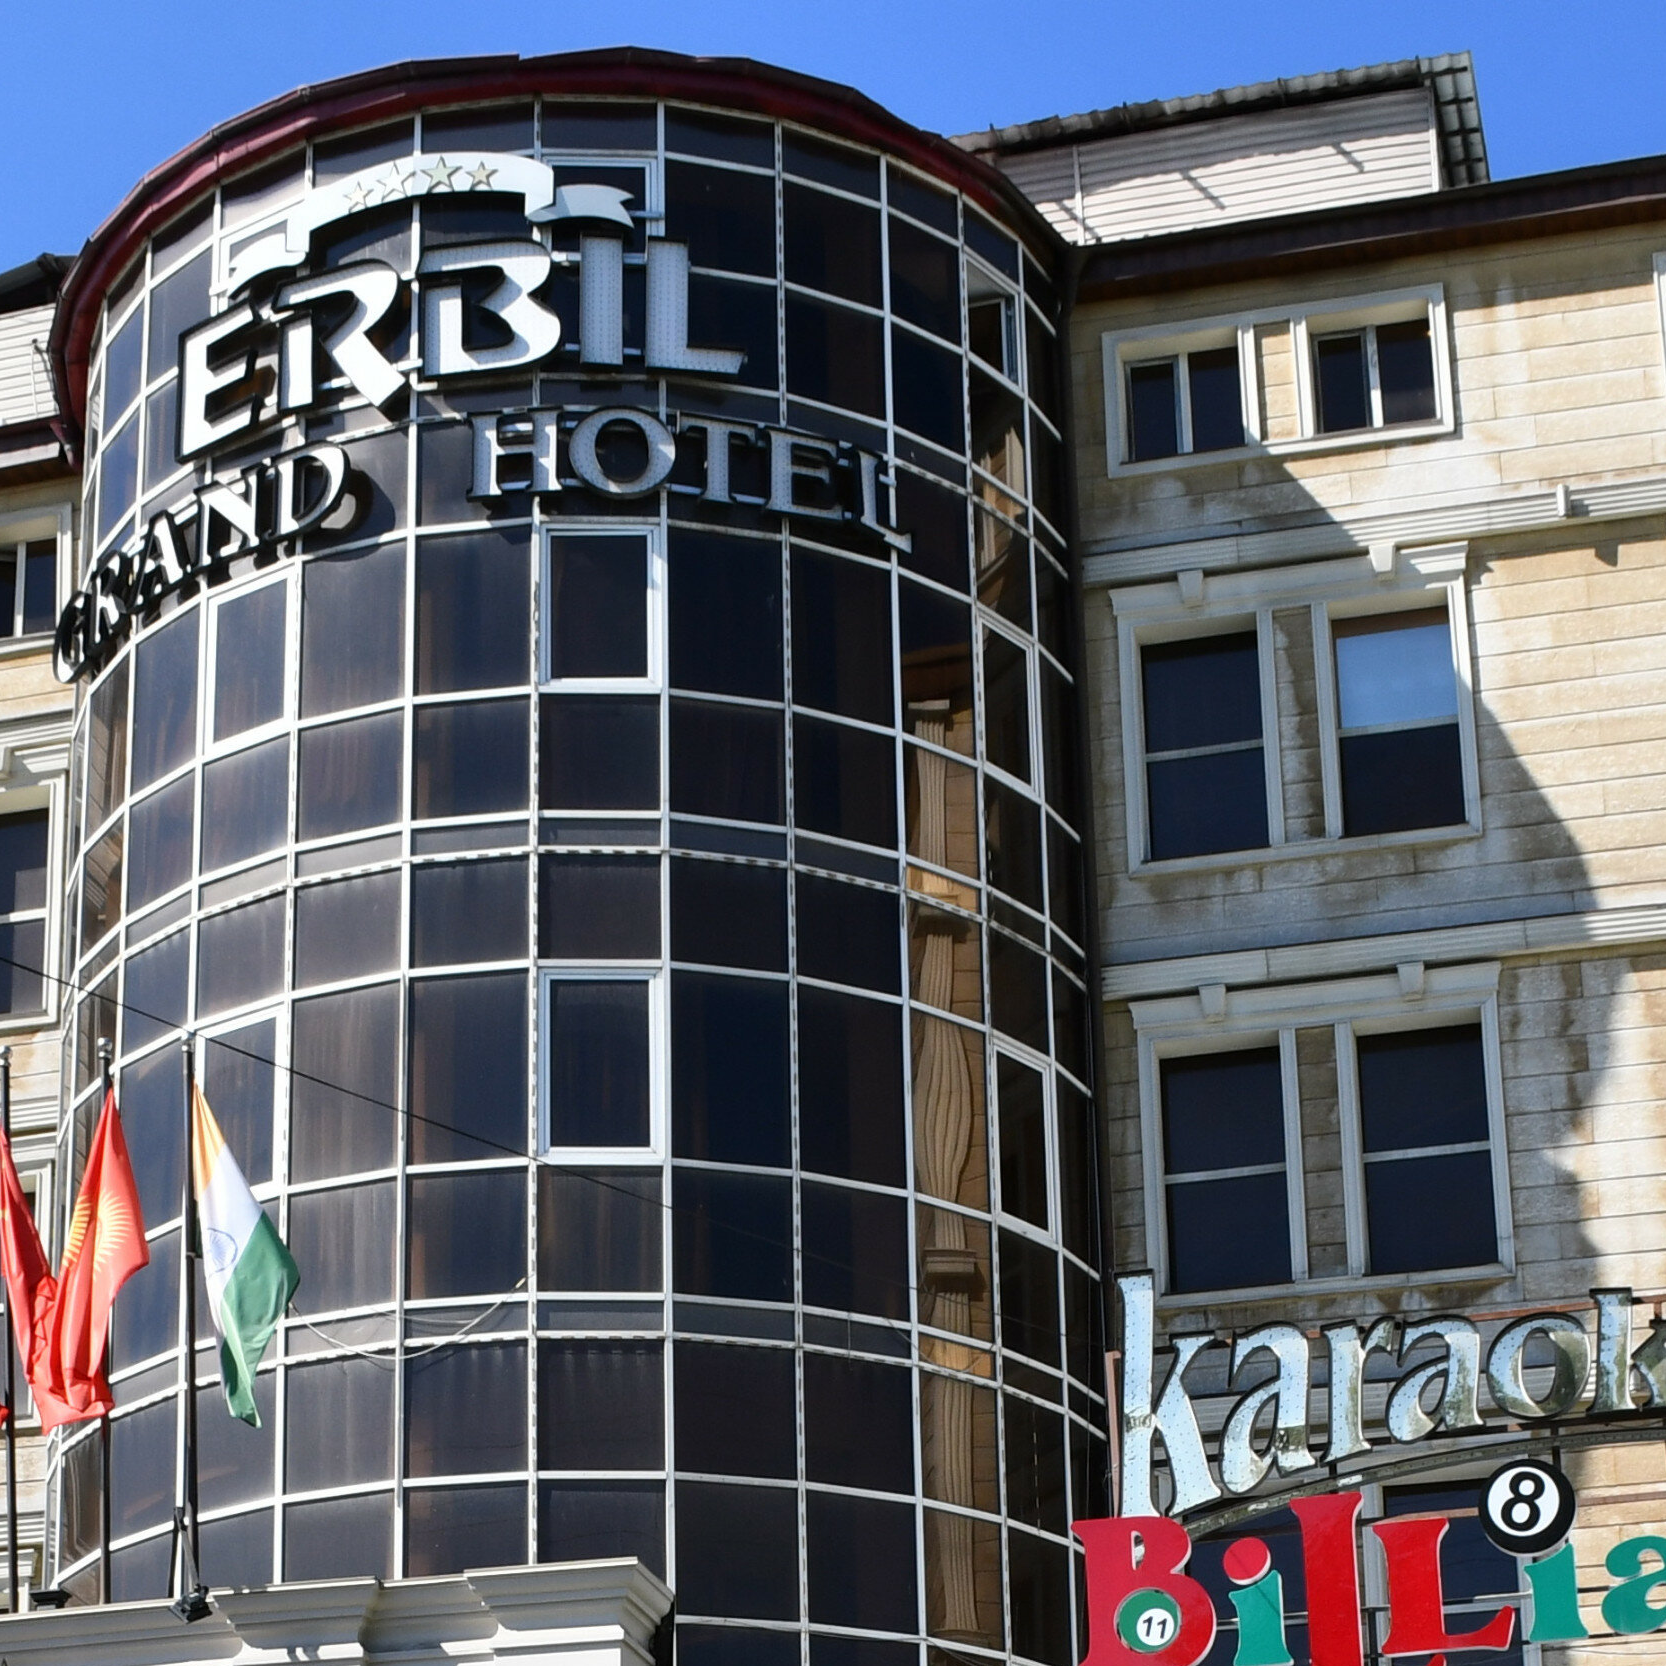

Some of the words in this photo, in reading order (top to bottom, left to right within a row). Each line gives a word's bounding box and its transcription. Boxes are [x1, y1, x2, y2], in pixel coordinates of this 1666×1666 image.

[175, 231, 746, 461] ERBIL
[52, 441, 350, 684] GRAND
[467, 405, 914, 552] HOTEL
[1500, 1471, 1545, 1531] 8
[1141, 1614, 1169, 1639] 11
